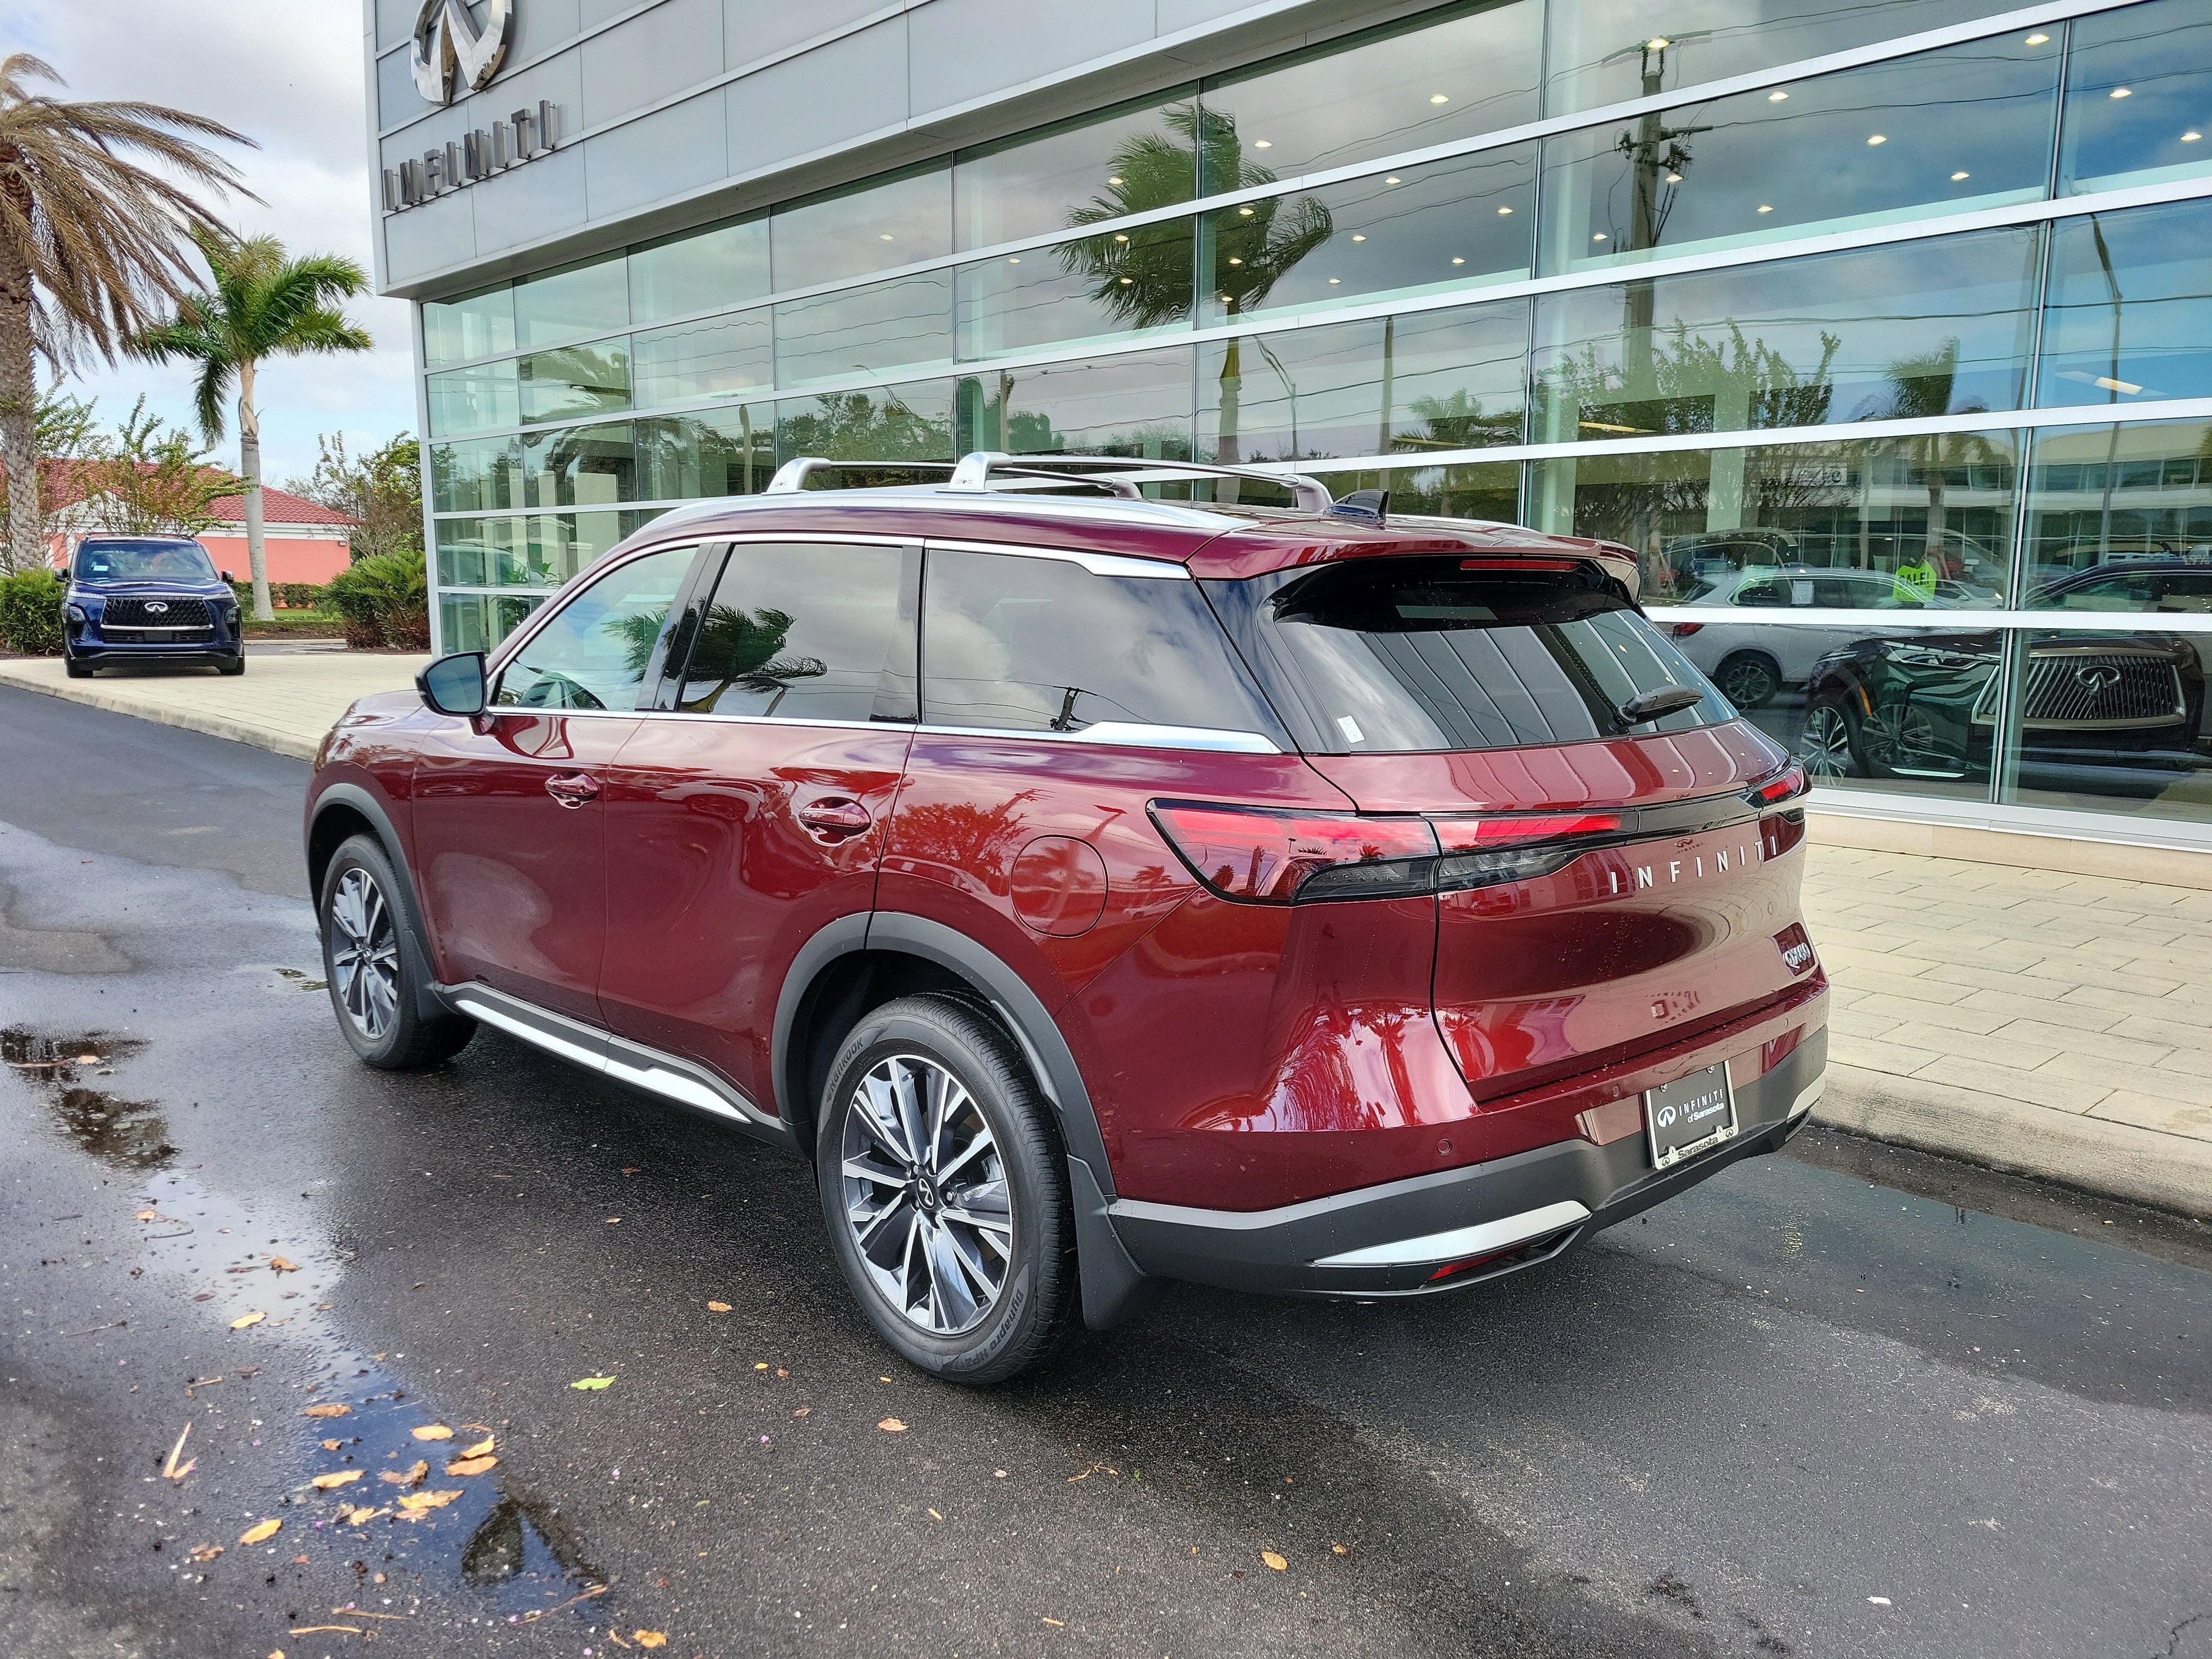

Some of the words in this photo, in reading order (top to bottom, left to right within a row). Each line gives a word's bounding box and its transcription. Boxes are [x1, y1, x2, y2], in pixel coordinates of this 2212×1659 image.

[383, 99, 555, 211] INFINITI
[1610, 836, 1778, 893] INFINITI
[1782, 942, 1811, 969] QX60
[829, 1036, 864, 1093] Hankook
[1679, 1088, 1723, 1116] INFINITI
[1693, 1102, 1724, 1120] Sarasota
[1678, 1137, 1718, 1159] Sarasota
[990, 1288, 1024, 1350] Dynapro
